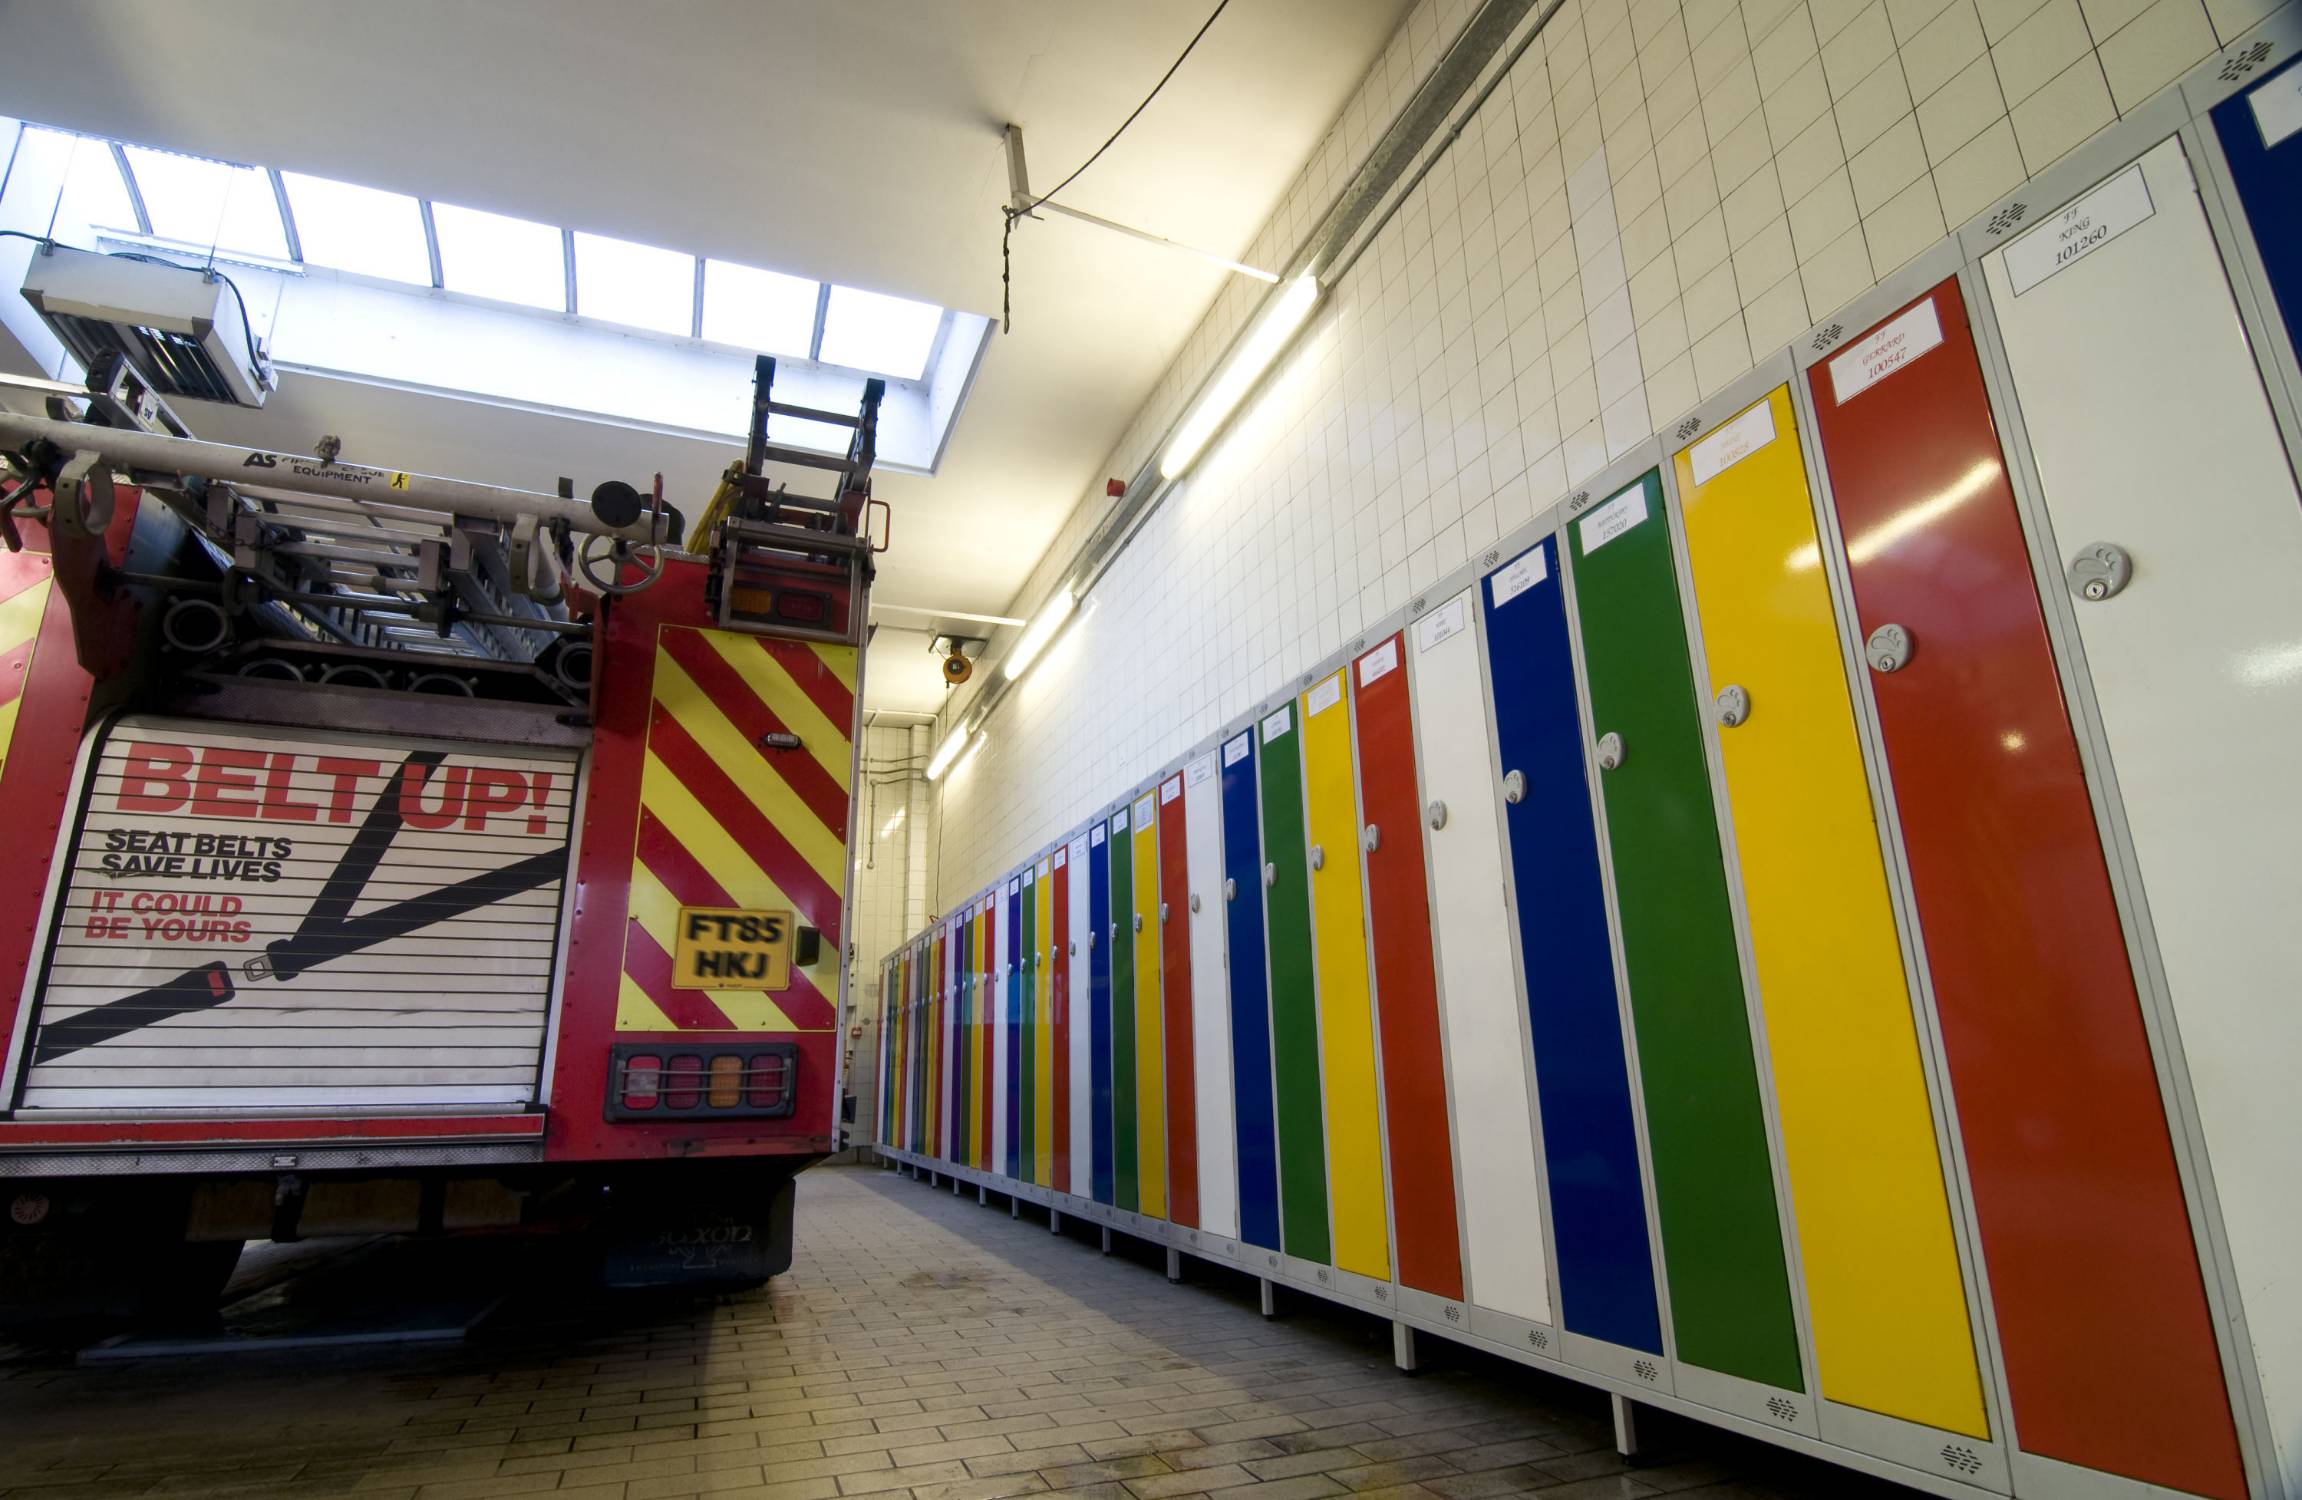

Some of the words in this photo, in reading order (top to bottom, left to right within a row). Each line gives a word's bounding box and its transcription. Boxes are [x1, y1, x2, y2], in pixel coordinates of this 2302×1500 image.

[2058, 215, 2091, 242] KING
[2055, 224, 2107, 266] 101260
[1867, 346, 1907, 380] 100547
[243, 452, 277, 468] AS
[294, 465, 372, 484] EQUIPMENT
[117, 742, 381, 823] BELT
[400, 763, 553, 835] UP!
[105, 829, 192, 855] SEAT
[194, 833, 293, 859] BELTS
[102, 854, 186, 878] SAVE
[190, 858, 282, 883] LIVES
[90, 891, 124, 914] IT
[131, 893, 243, 917] COULD
[84, 916, 132, 940] BE
[141, 918, 252, 943] YOURS
[685, 912, 784, 944] FT85
[692, 950, 769, 979] HKJ
